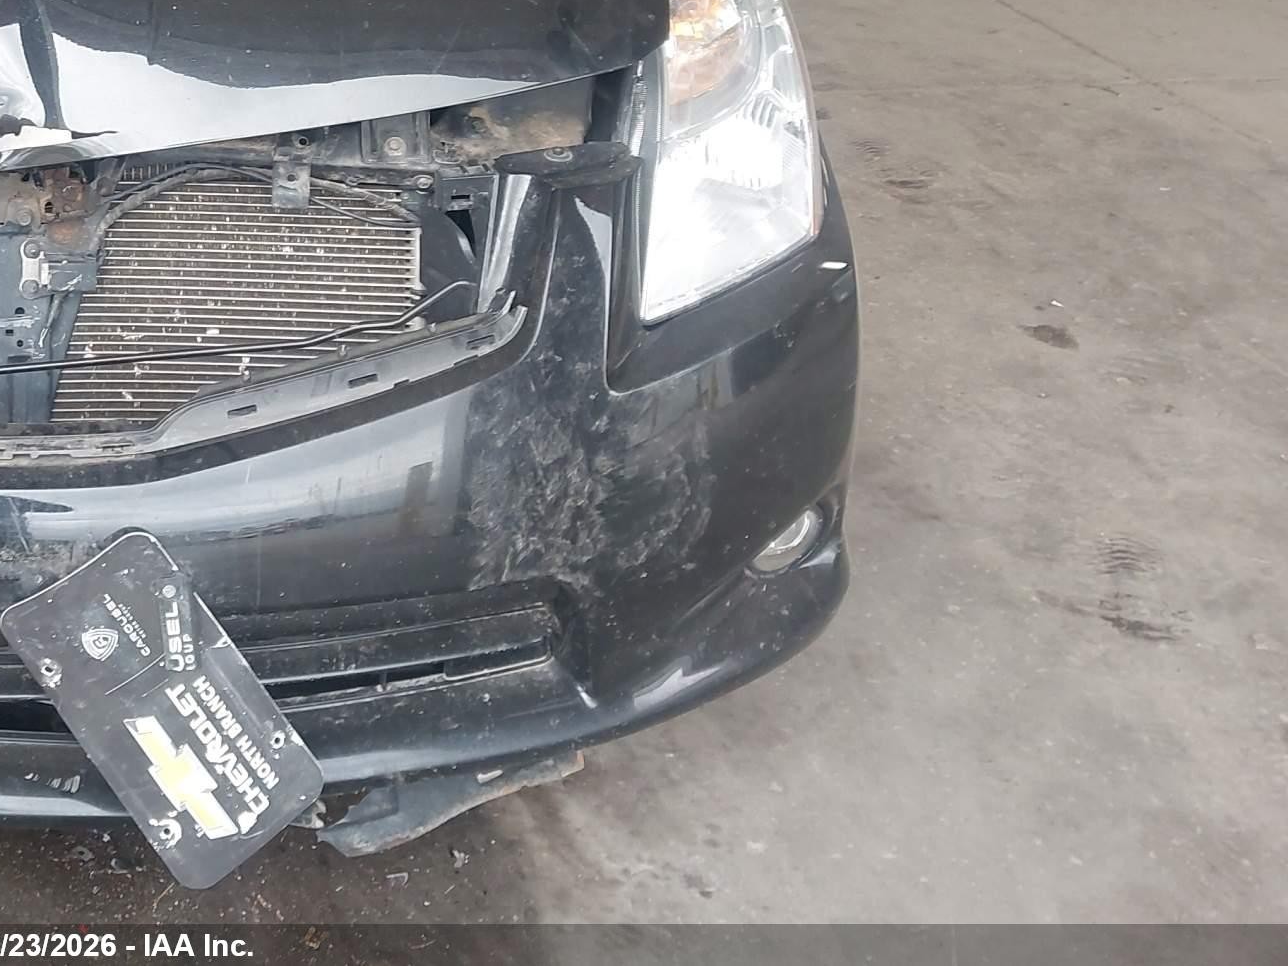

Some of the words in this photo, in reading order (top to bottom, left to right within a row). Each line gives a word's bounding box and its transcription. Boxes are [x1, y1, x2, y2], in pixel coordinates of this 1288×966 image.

[103, 593, 151, 657] CAROUSEL
[192, 675, 243, 739] BRANCH
[164, 684, 270, 815] CHEVROLET
[235, 734, 280, 790] NORTH
